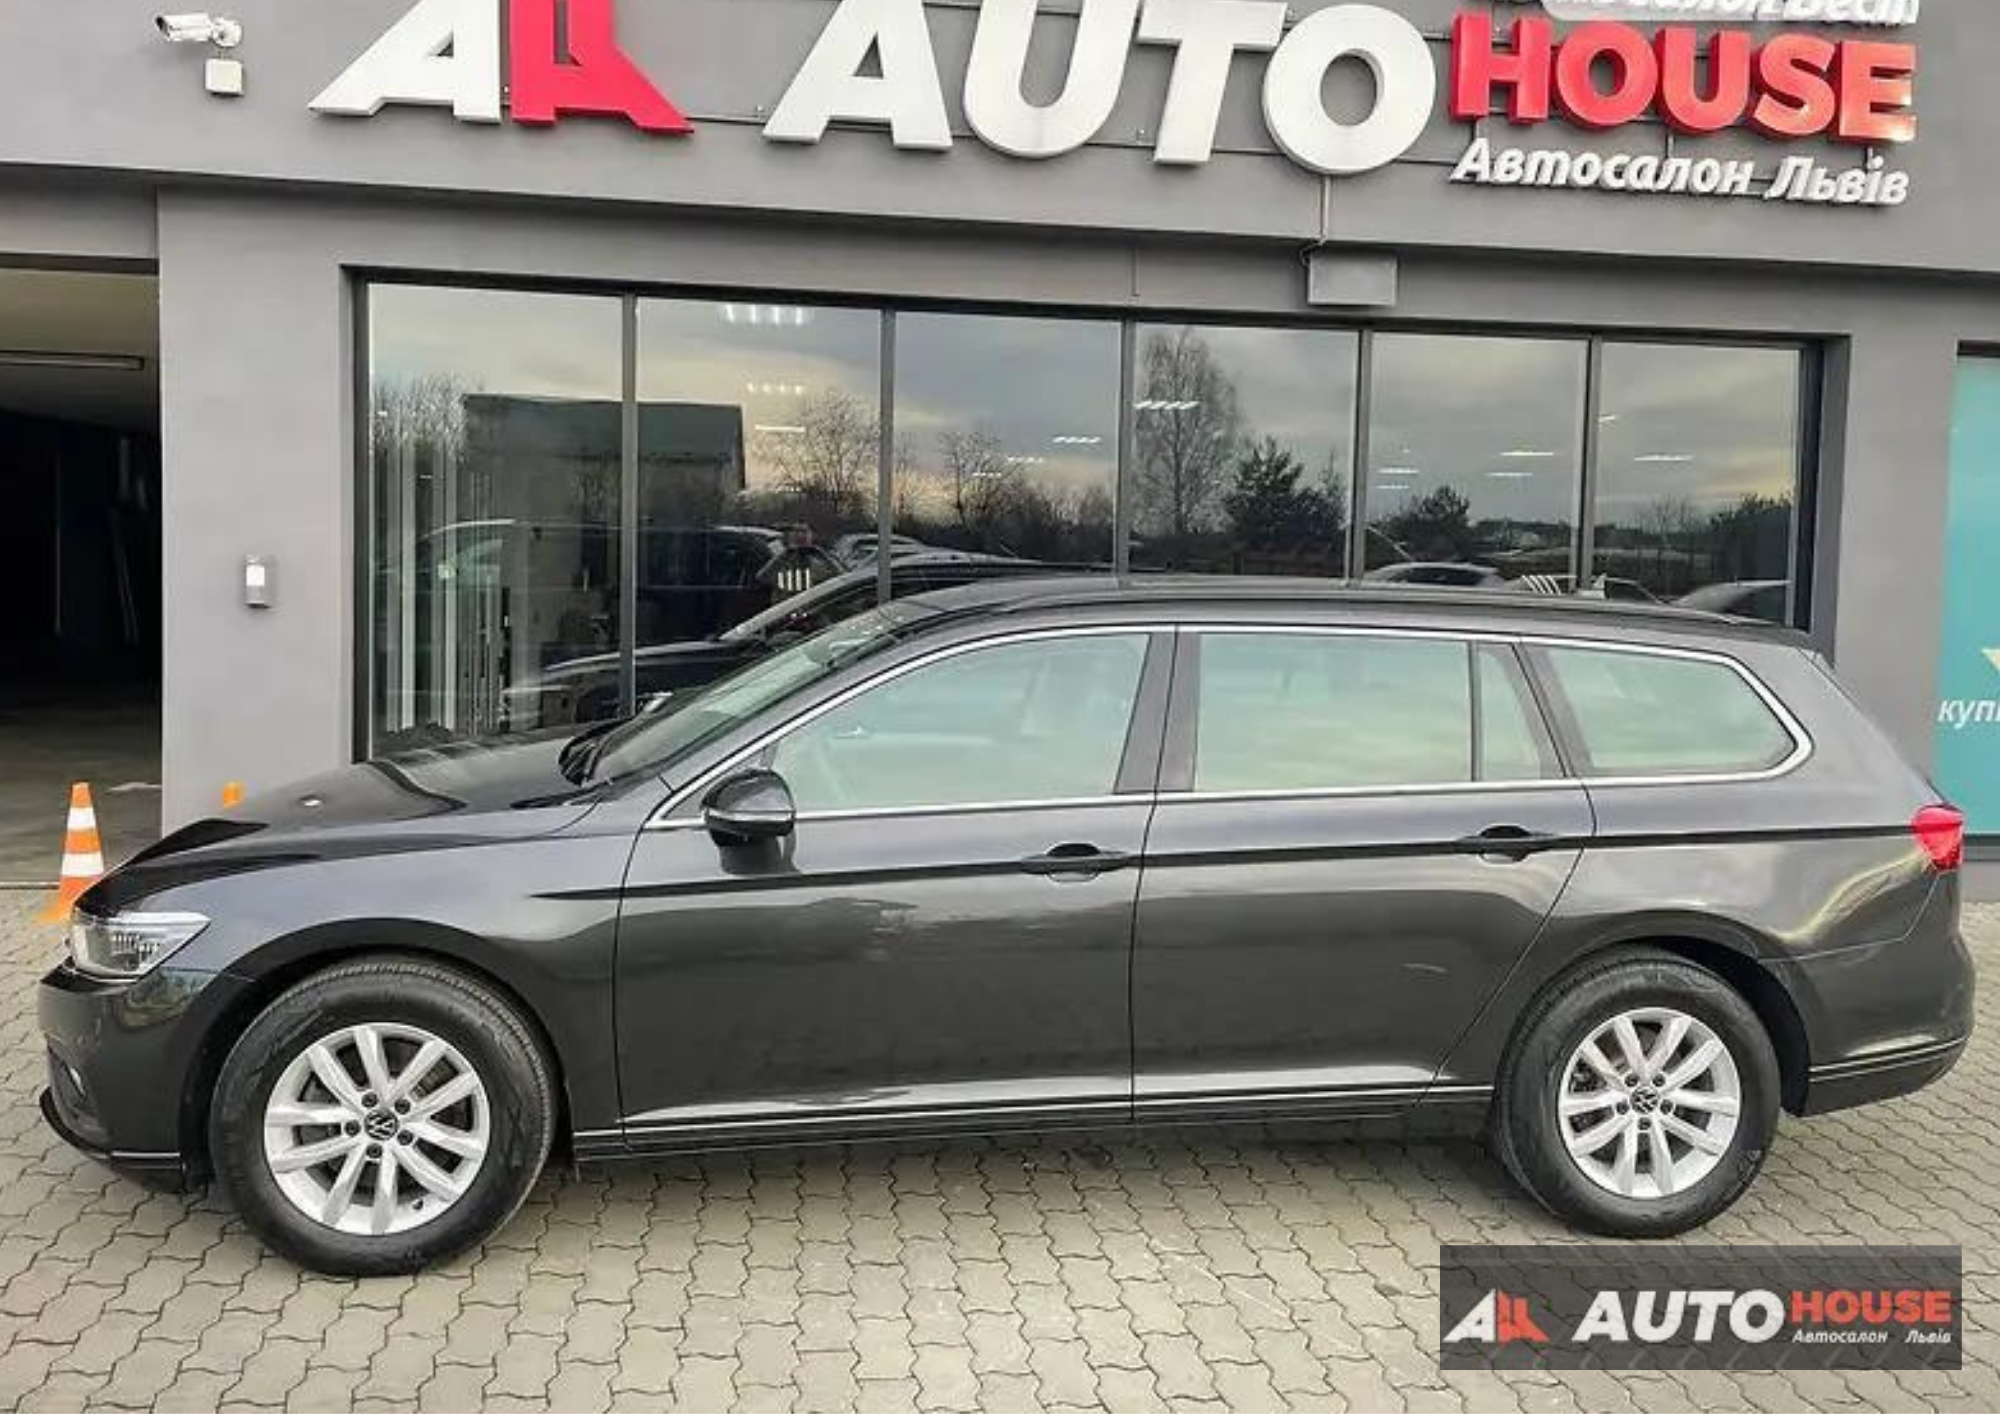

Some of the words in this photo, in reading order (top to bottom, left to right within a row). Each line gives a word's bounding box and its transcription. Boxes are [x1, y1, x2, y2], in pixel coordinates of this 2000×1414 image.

[762, 0, 1436, 175] AUTO
[1450, 12, 1916, 142] HOUSE
[1450, 137, 1753, 196] Автосалон
[1764, 156, 1910, 205] Львів
